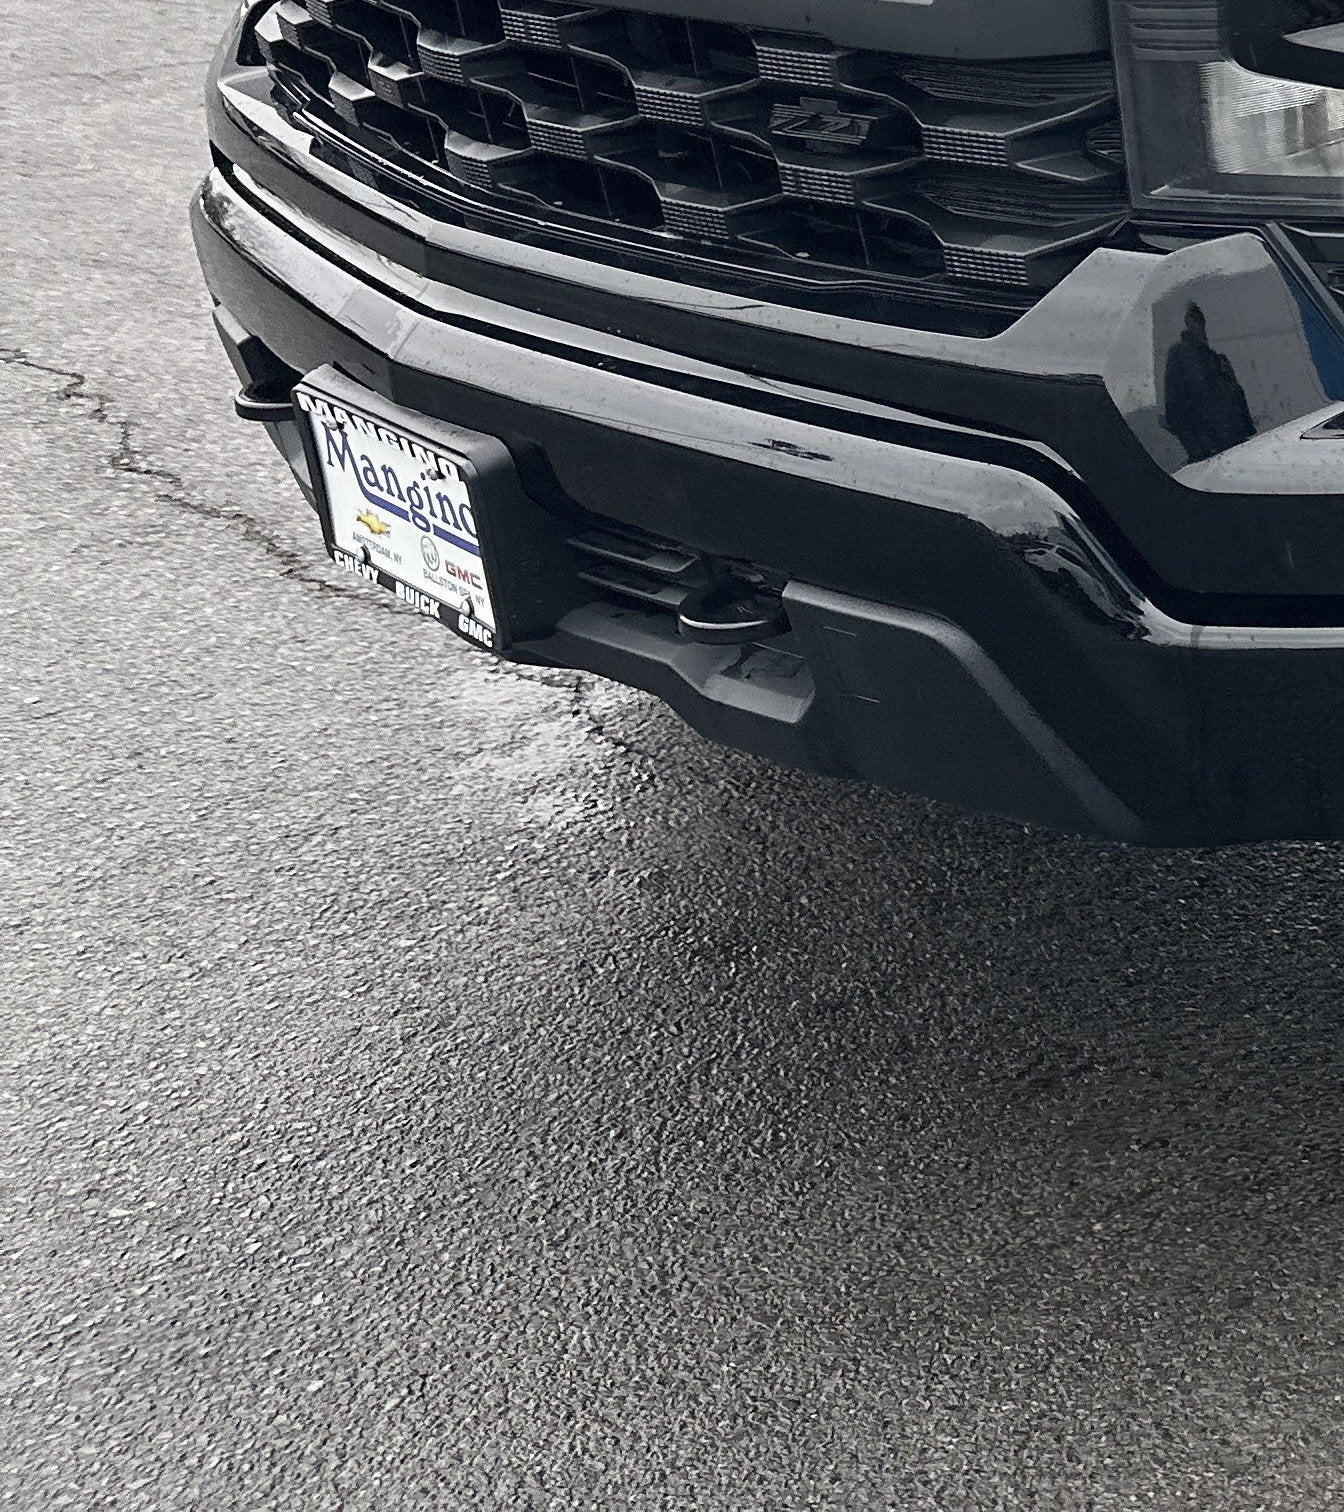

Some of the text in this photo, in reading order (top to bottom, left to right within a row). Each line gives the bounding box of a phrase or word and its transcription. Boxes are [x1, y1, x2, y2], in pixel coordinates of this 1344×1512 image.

[333, 550, 493, 648] CHEVY BUICK GMC
[444, 559, 484, 590] GMC
